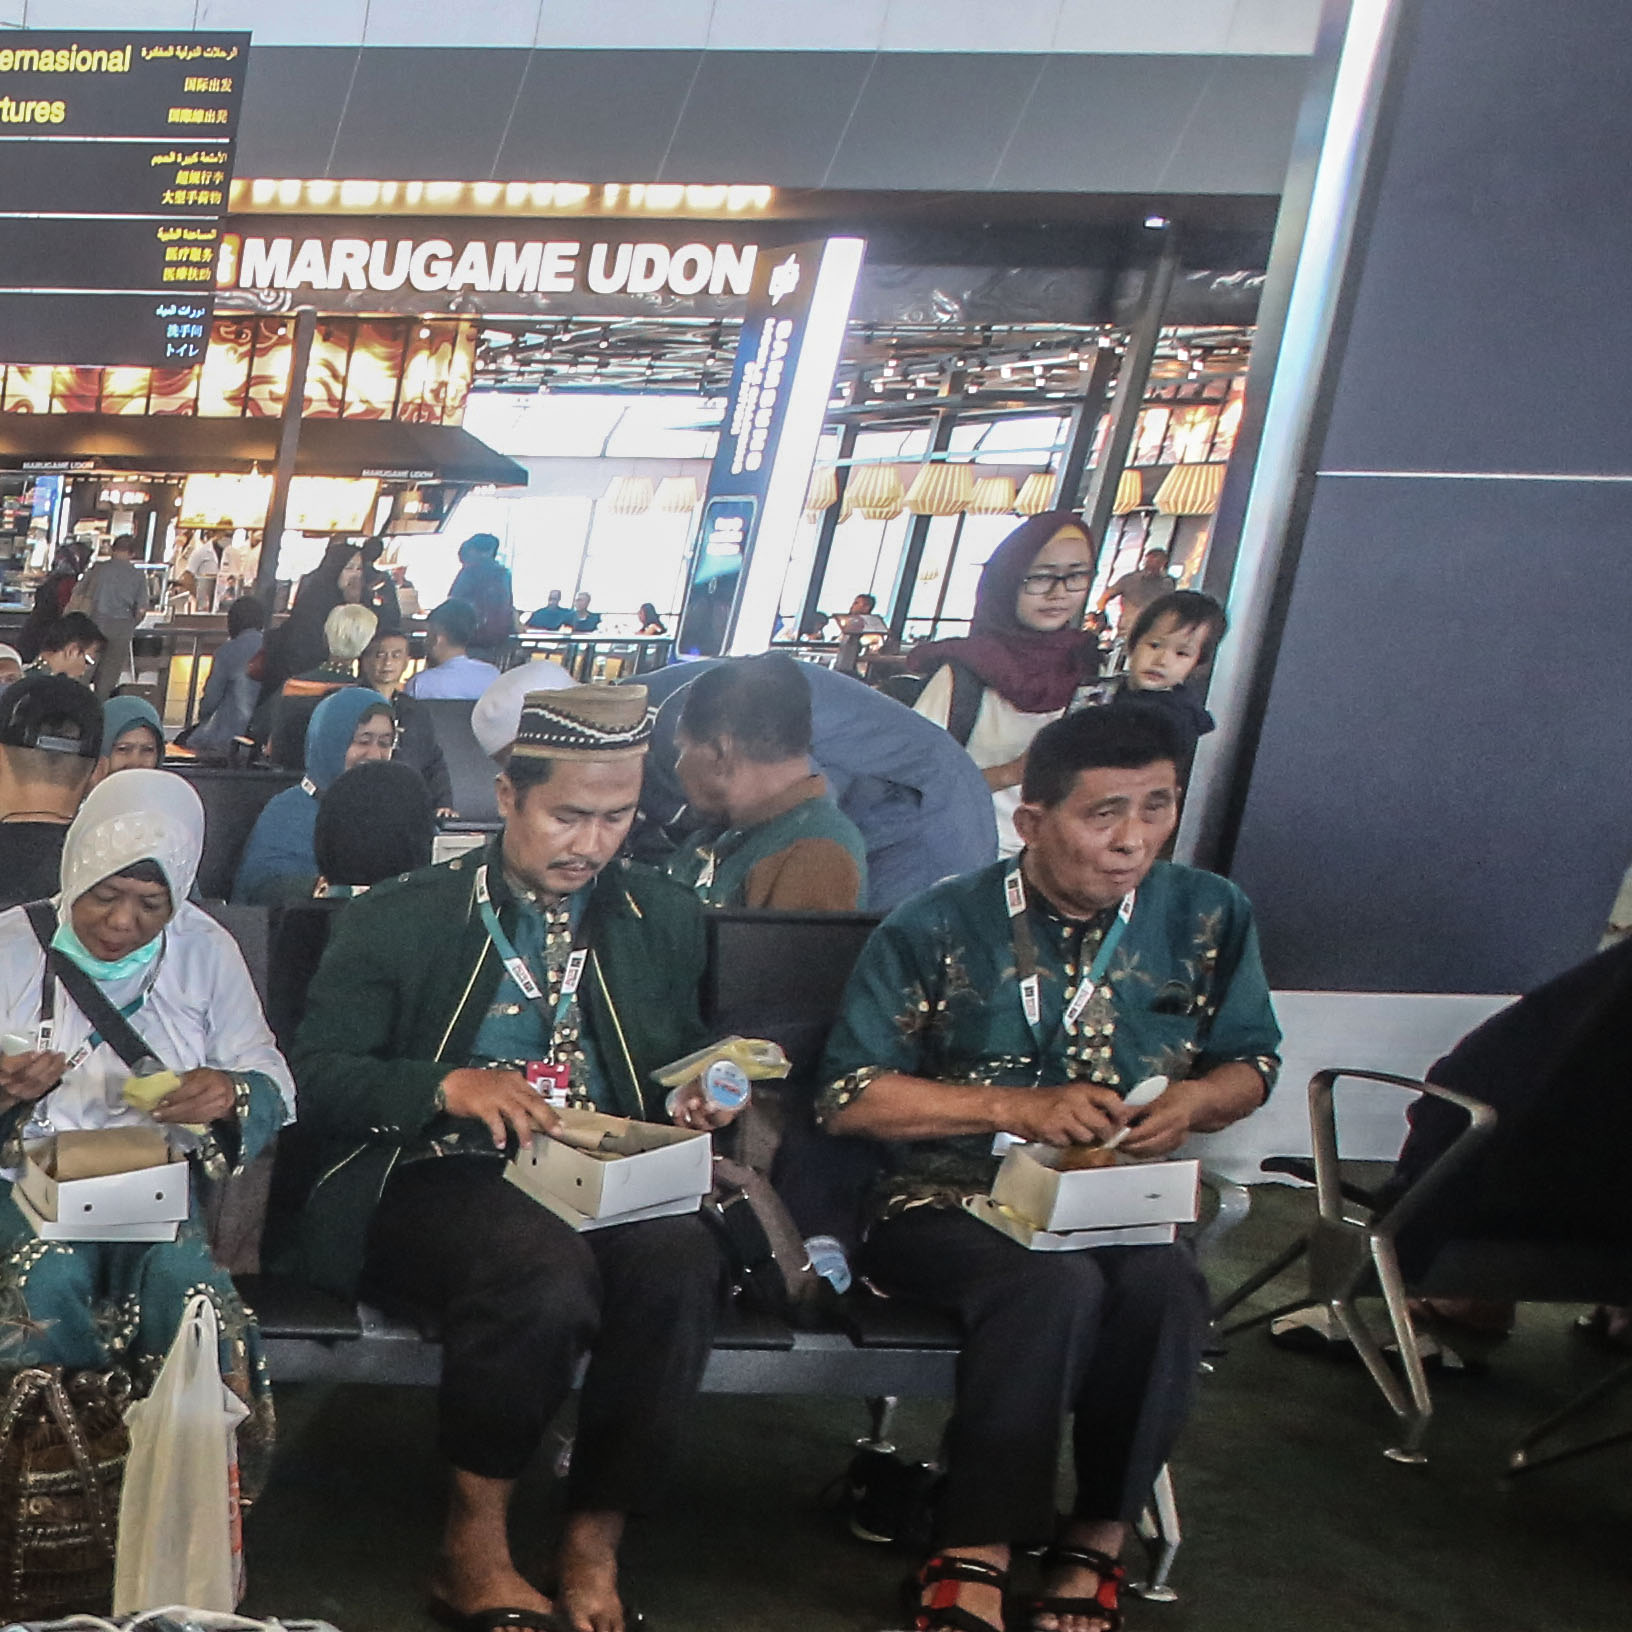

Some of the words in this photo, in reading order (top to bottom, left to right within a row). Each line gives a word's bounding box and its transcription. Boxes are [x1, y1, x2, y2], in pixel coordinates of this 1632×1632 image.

[239, 238, 581, 292] MARUGAME
[587, 244, 758, 296] UDON
[166, 343, 199, 357] トイレ
